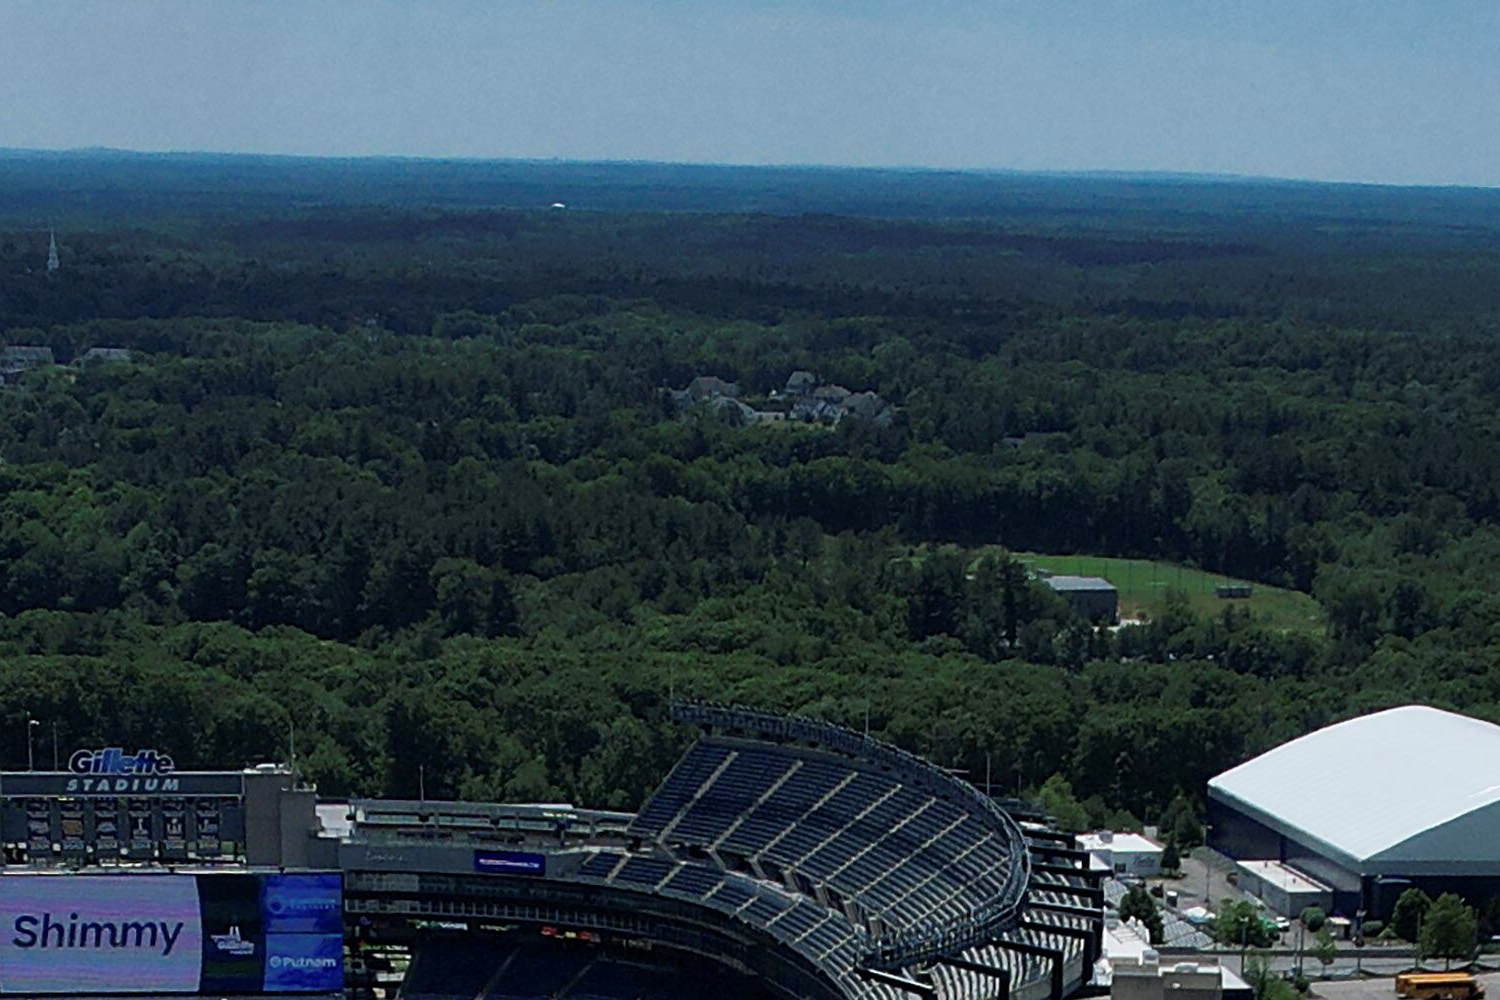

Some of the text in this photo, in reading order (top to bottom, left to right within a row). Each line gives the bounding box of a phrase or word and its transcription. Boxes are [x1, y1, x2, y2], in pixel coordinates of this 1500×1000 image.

[69, 748, 175, 775] Gillette
[66, 778, 179, 791] STADIUM
[12, 912, 184, 956] Shimmy
[282, 957, 336, 968] Putnam
